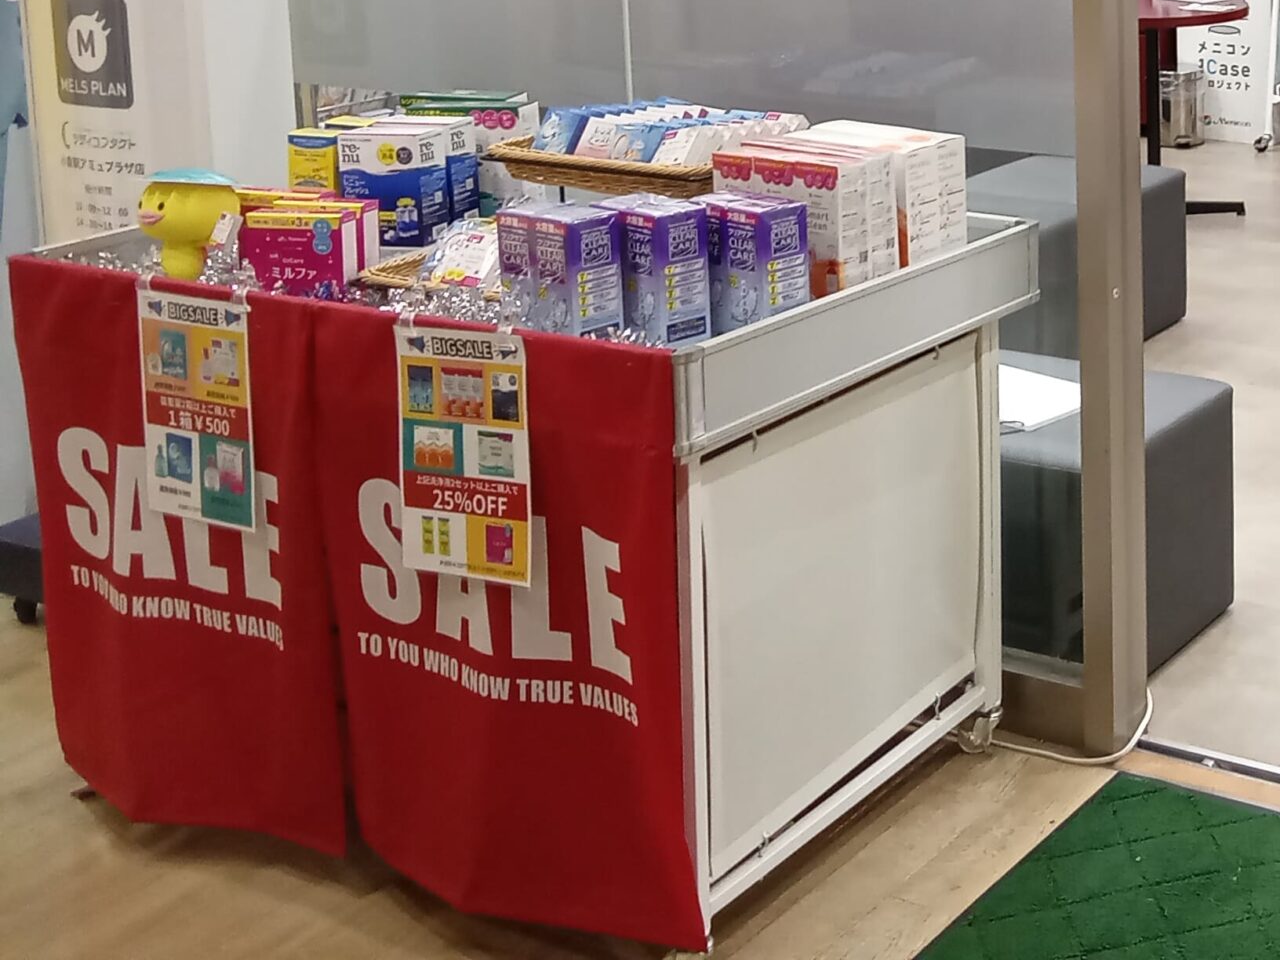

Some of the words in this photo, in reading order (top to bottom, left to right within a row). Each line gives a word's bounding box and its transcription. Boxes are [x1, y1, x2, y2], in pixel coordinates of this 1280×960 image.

[1198, 41, 1251, 56] メニコン
[91, 80, 127, 98] PLAN
[1207, 80, 1251, 91] ロジェクト
[341, 153, 361, 164] nu
[271, 266, 317, 280] ミルファ
[432, 489, 508, 518] 25%OFF
[71, 564, 91, 588] TO
[131, 595, 191, 620] KNOW
[193, 602, 233, 634] TRUE
[235, 613, 285, 651] VALUE
[357, 631, 382, 657] TO
[387, 636, 420, 668] YOU
[423, 647, 459, 683] WHO
[461, 662, 511, 702] KNOW
[516, 677, 574, 704] TRUE
[579, 682, 640, 728] VALUES
